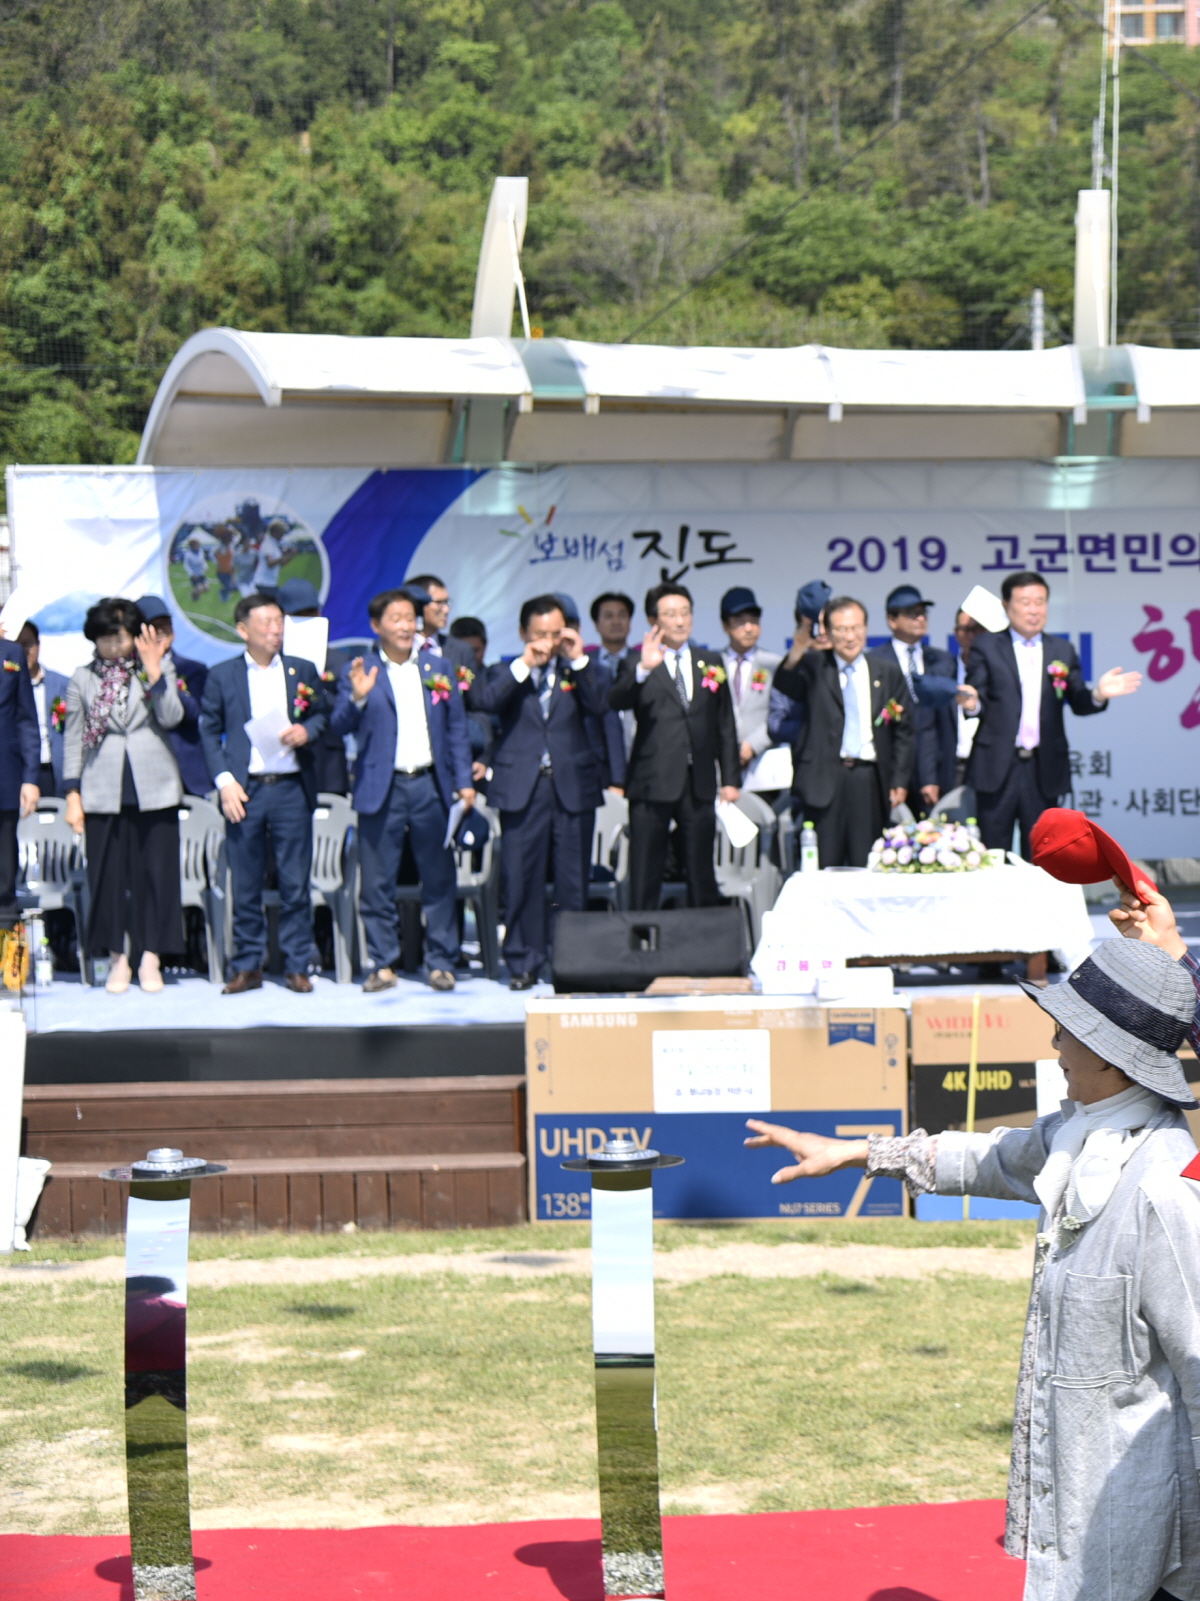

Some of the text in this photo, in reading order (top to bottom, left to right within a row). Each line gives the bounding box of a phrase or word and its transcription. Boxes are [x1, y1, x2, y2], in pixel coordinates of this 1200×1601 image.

[529, 524, 754, 584] 보배섬 진도
[827, 536, 962, 573] 2019.
[559, 1013, 638, 1029] SAMSUNG
[942, 1071, 968, 1091] 4K
[974, 1070, 1013, 1091] UHD
[539, 1127, 653, 1157] UHD TV
[541, 1192, 582, 1218] 138
[803, 1202, 842, 1214] SERIES
